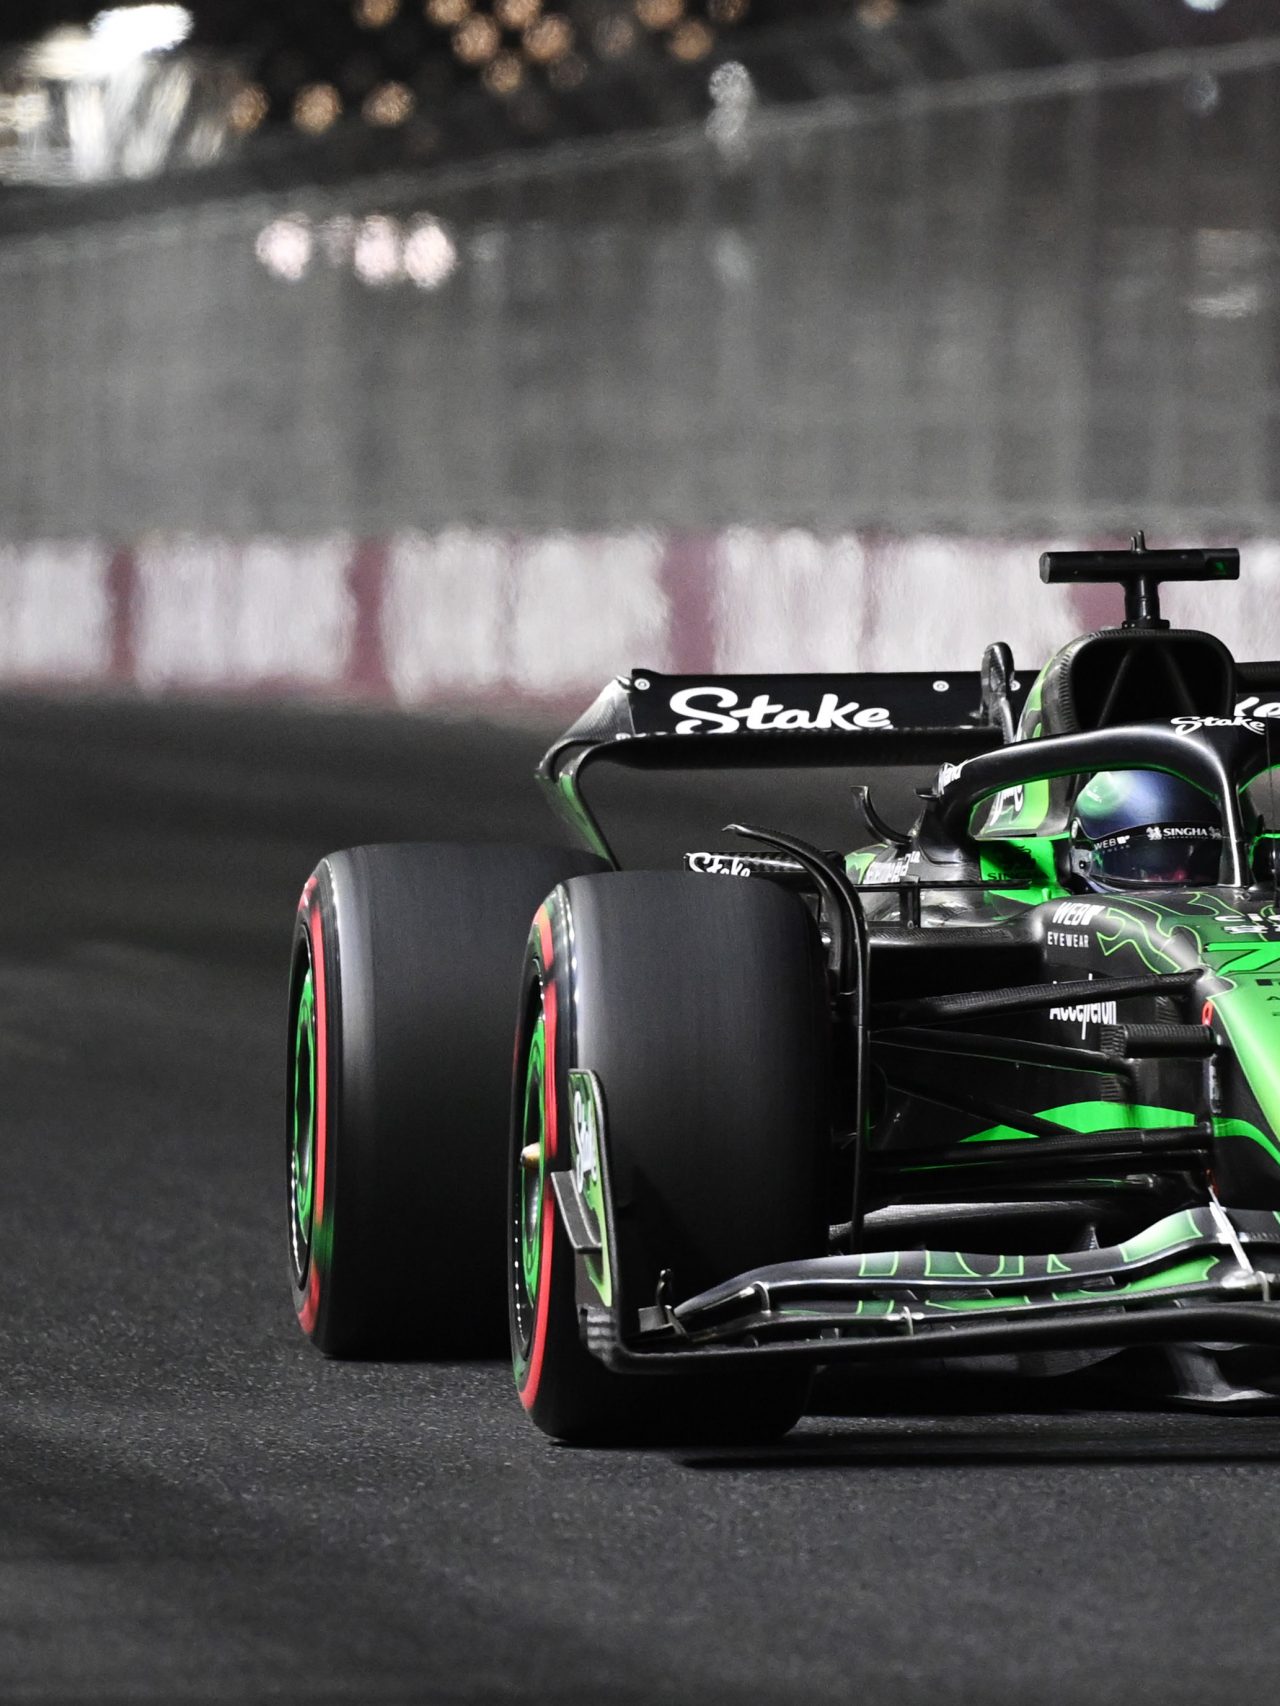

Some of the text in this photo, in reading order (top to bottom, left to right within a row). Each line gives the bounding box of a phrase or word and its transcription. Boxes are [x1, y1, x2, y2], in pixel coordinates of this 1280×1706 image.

[669, 686, 894, 735] Stake
[1170, 715, 1265, 737] Stake
[1163, 827, 1208, 837] SINGHA
[1047, 931, 1090, 948] EYEWEAR
